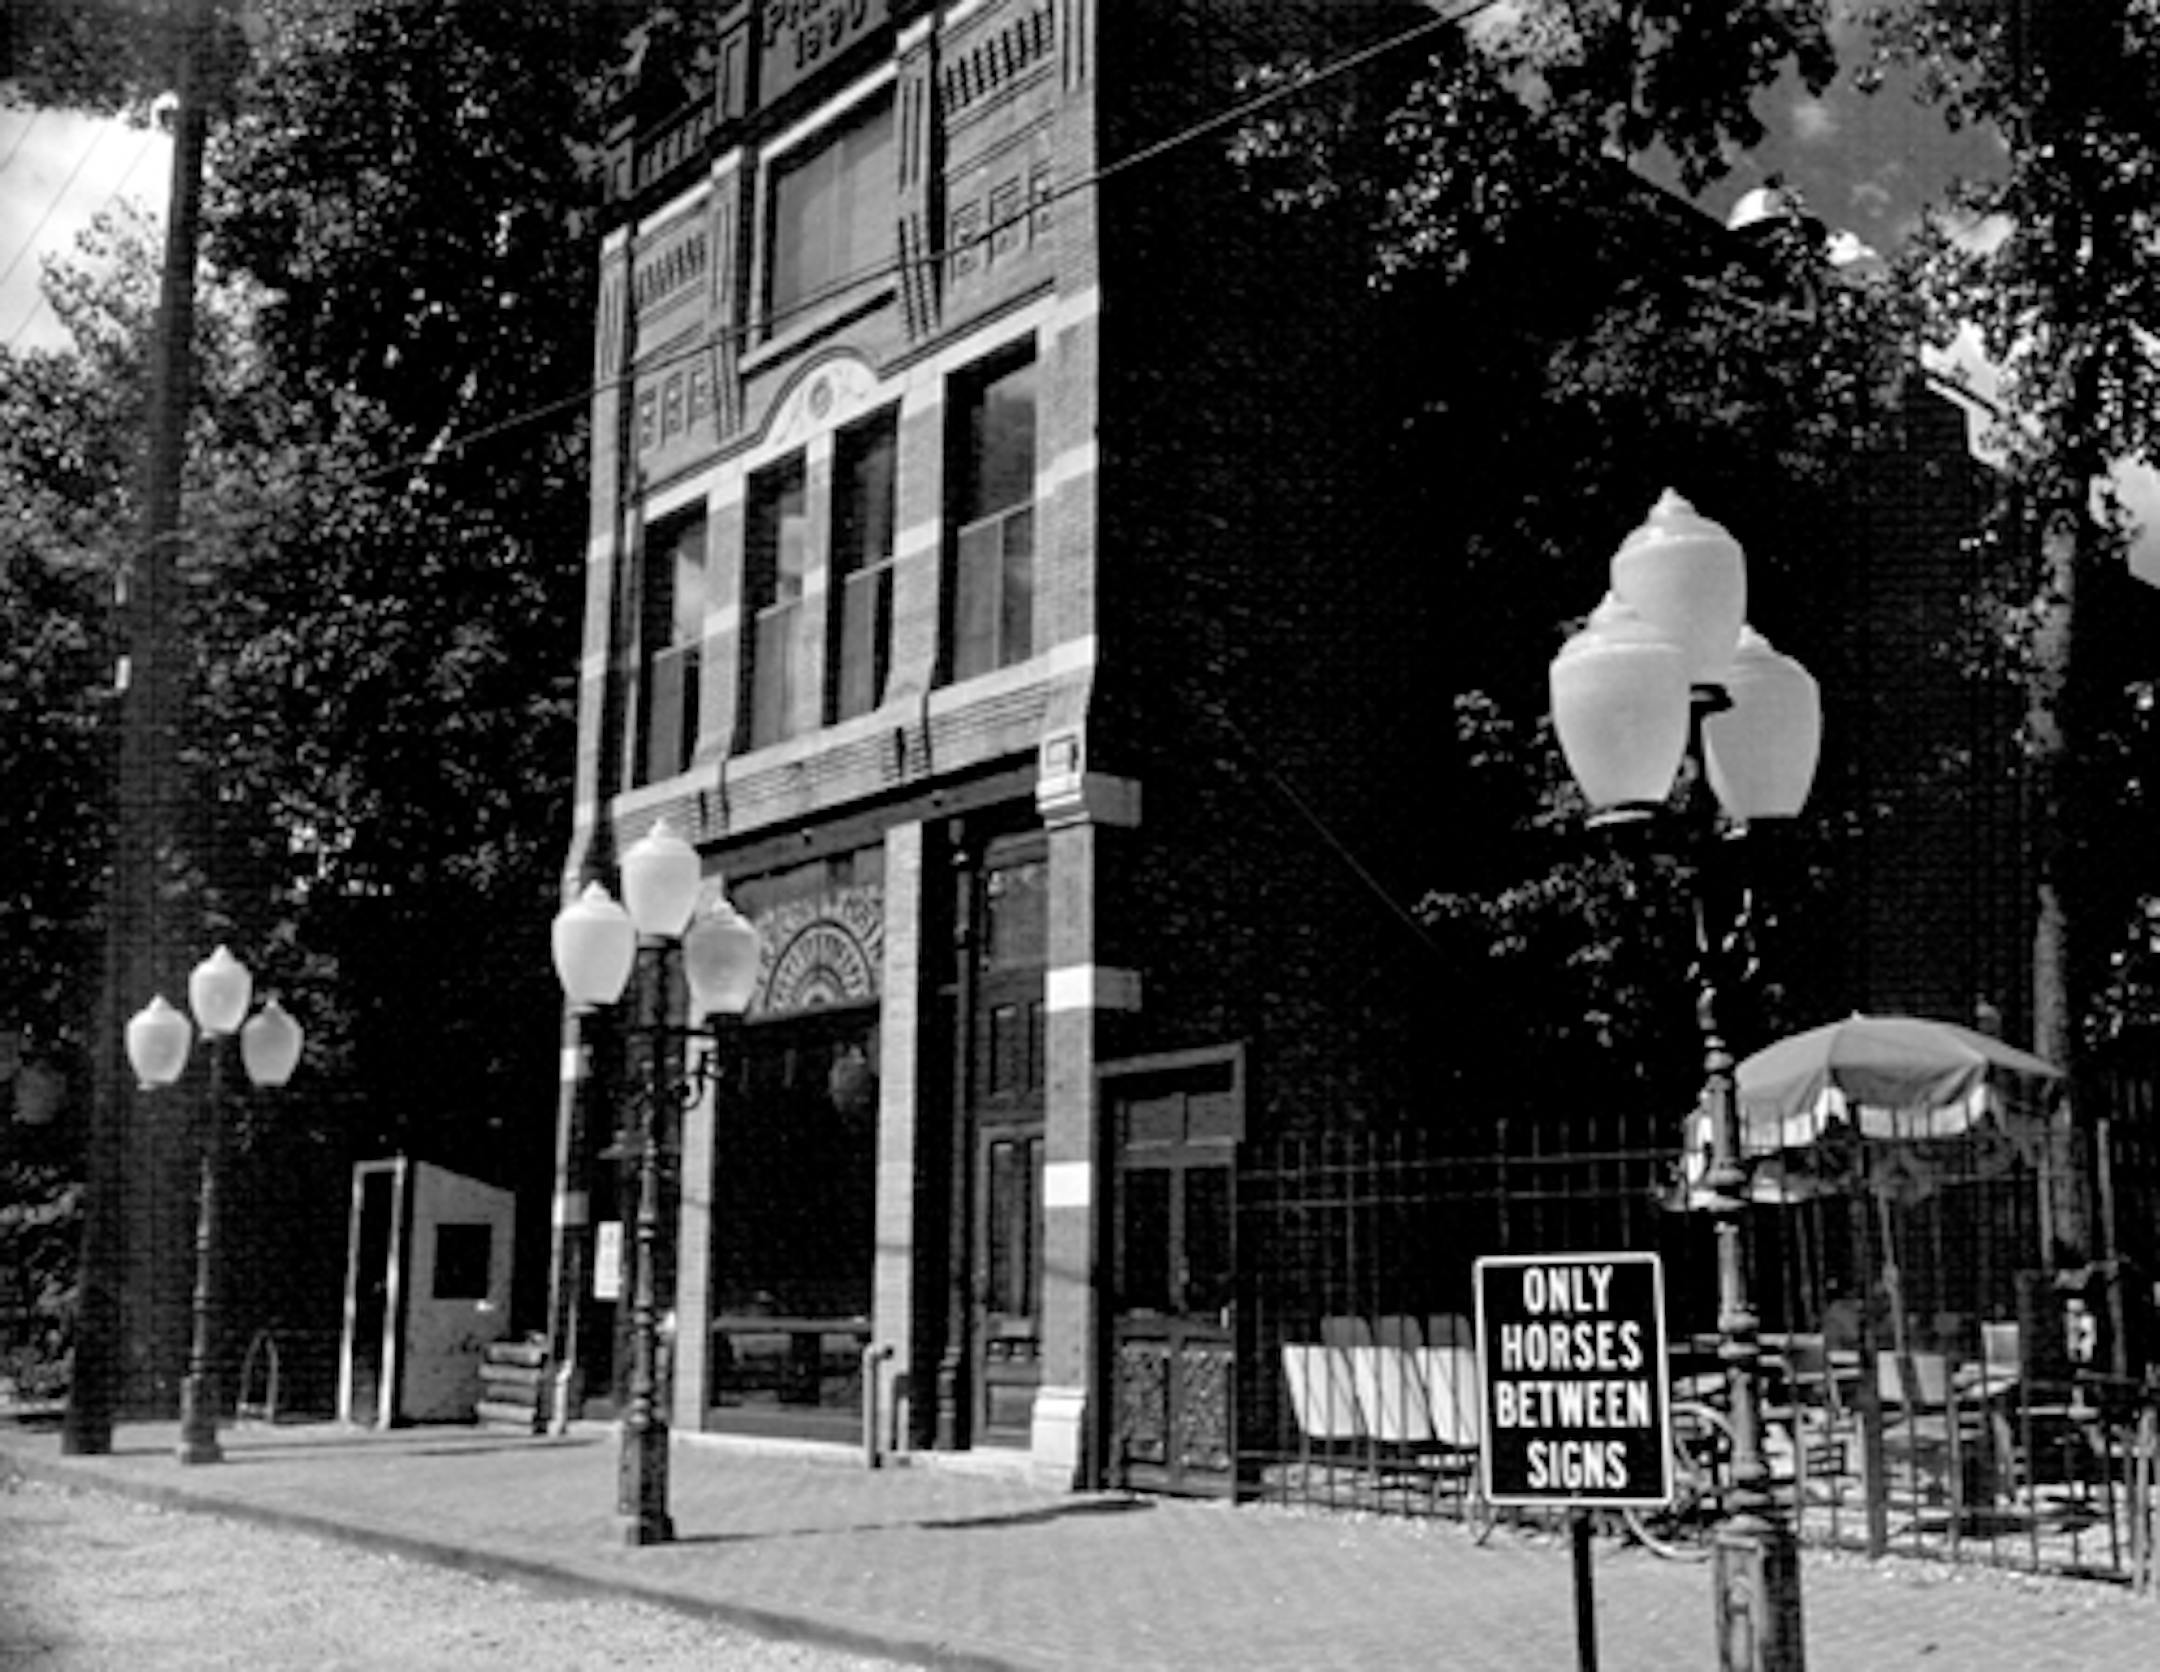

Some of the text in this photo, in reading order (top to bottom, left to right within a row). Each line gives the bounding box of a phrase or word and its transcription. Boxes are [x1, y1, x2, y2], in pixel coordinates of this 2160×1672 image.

[1523, 1265, 1613, 1314] ONLY
[1501, 1321, 1643, 1372] HORSES
[1496, 1381, 1650, 1428] BETWEEN
[1527, 1440, 1627, 1489] SIGNS
